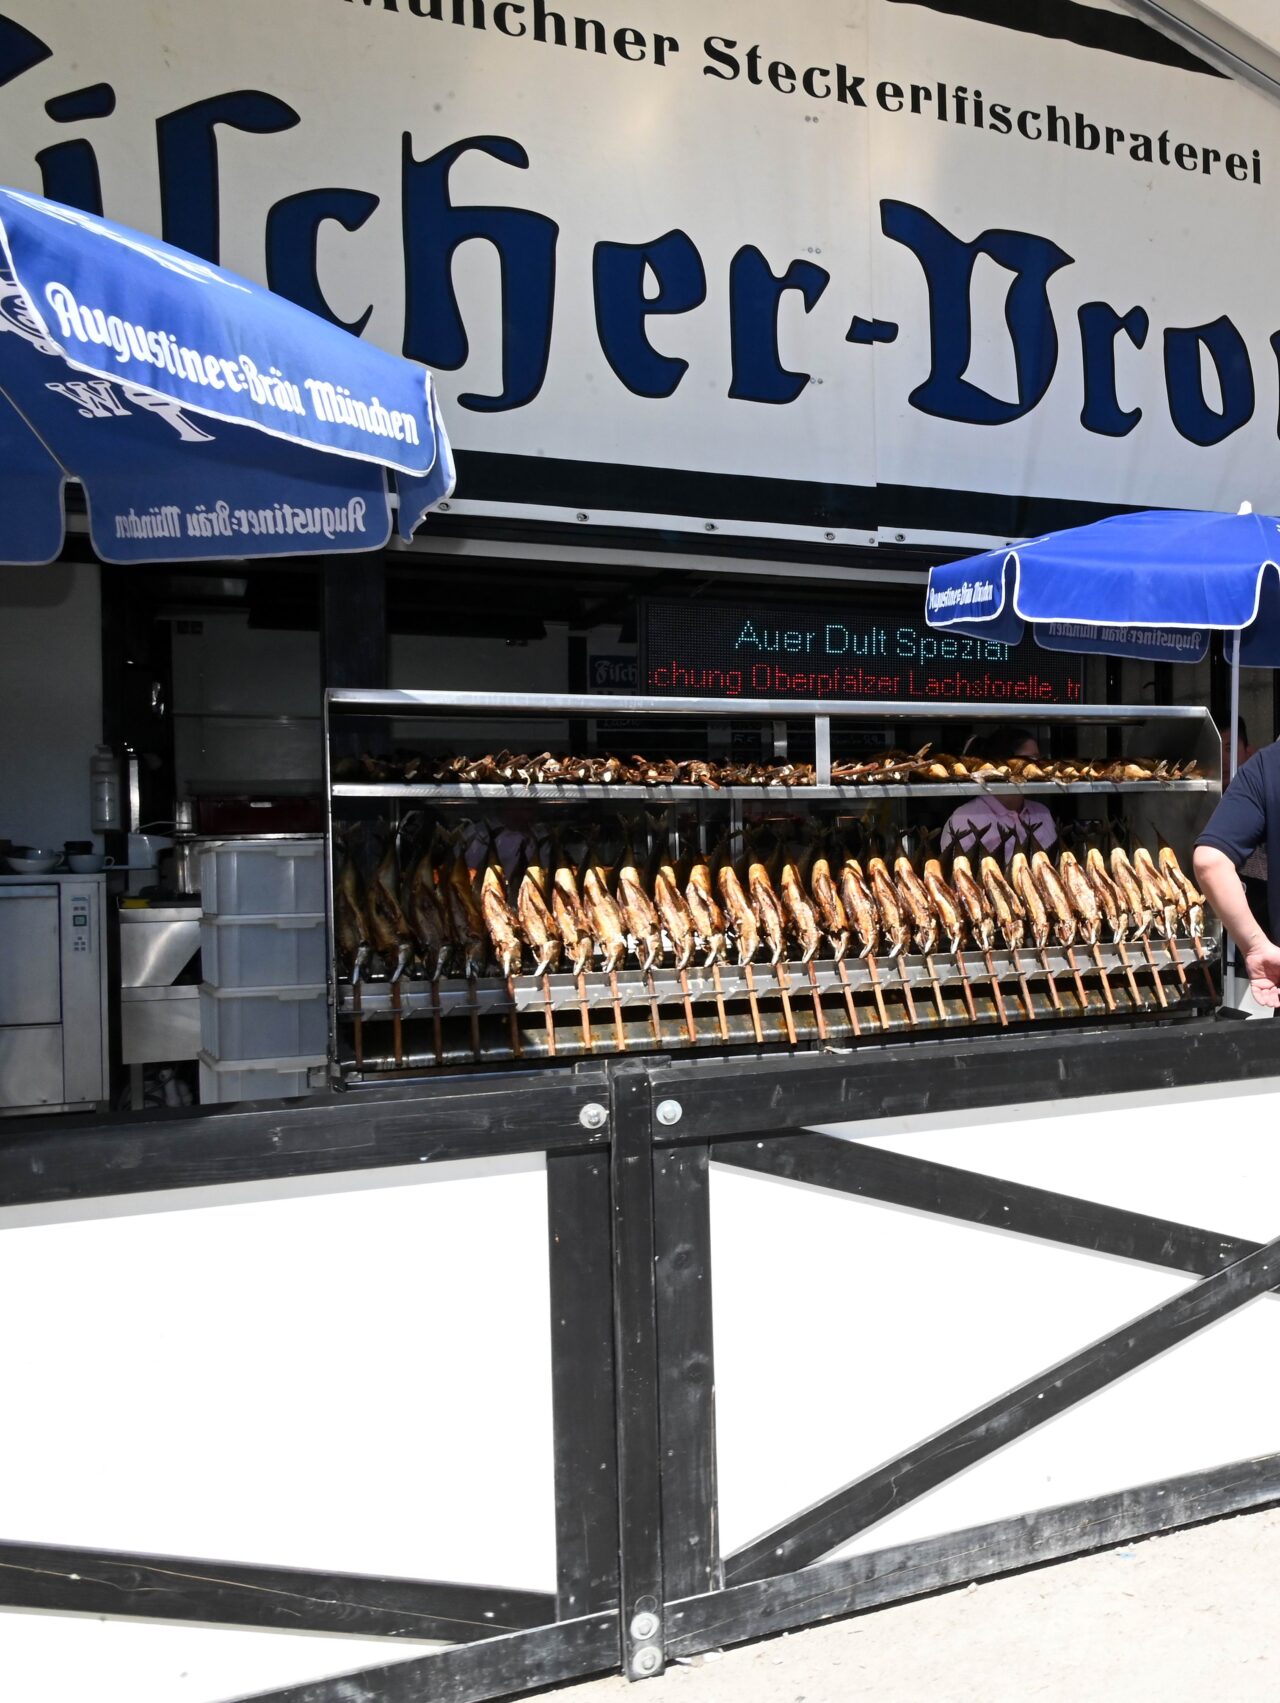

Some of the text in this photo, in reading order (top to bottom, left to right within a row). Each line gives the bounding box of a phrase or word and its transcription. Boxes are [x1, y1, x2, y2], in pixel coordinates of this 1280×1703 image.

[344, 0, 1263, 184] nchner Steckerlfischbraterei
[304, 377, 419, 445] München
[735, 620, 816, 652] Auer
[826, 623, 887, 656] Dult
[648, 660, 742, 694] chung
